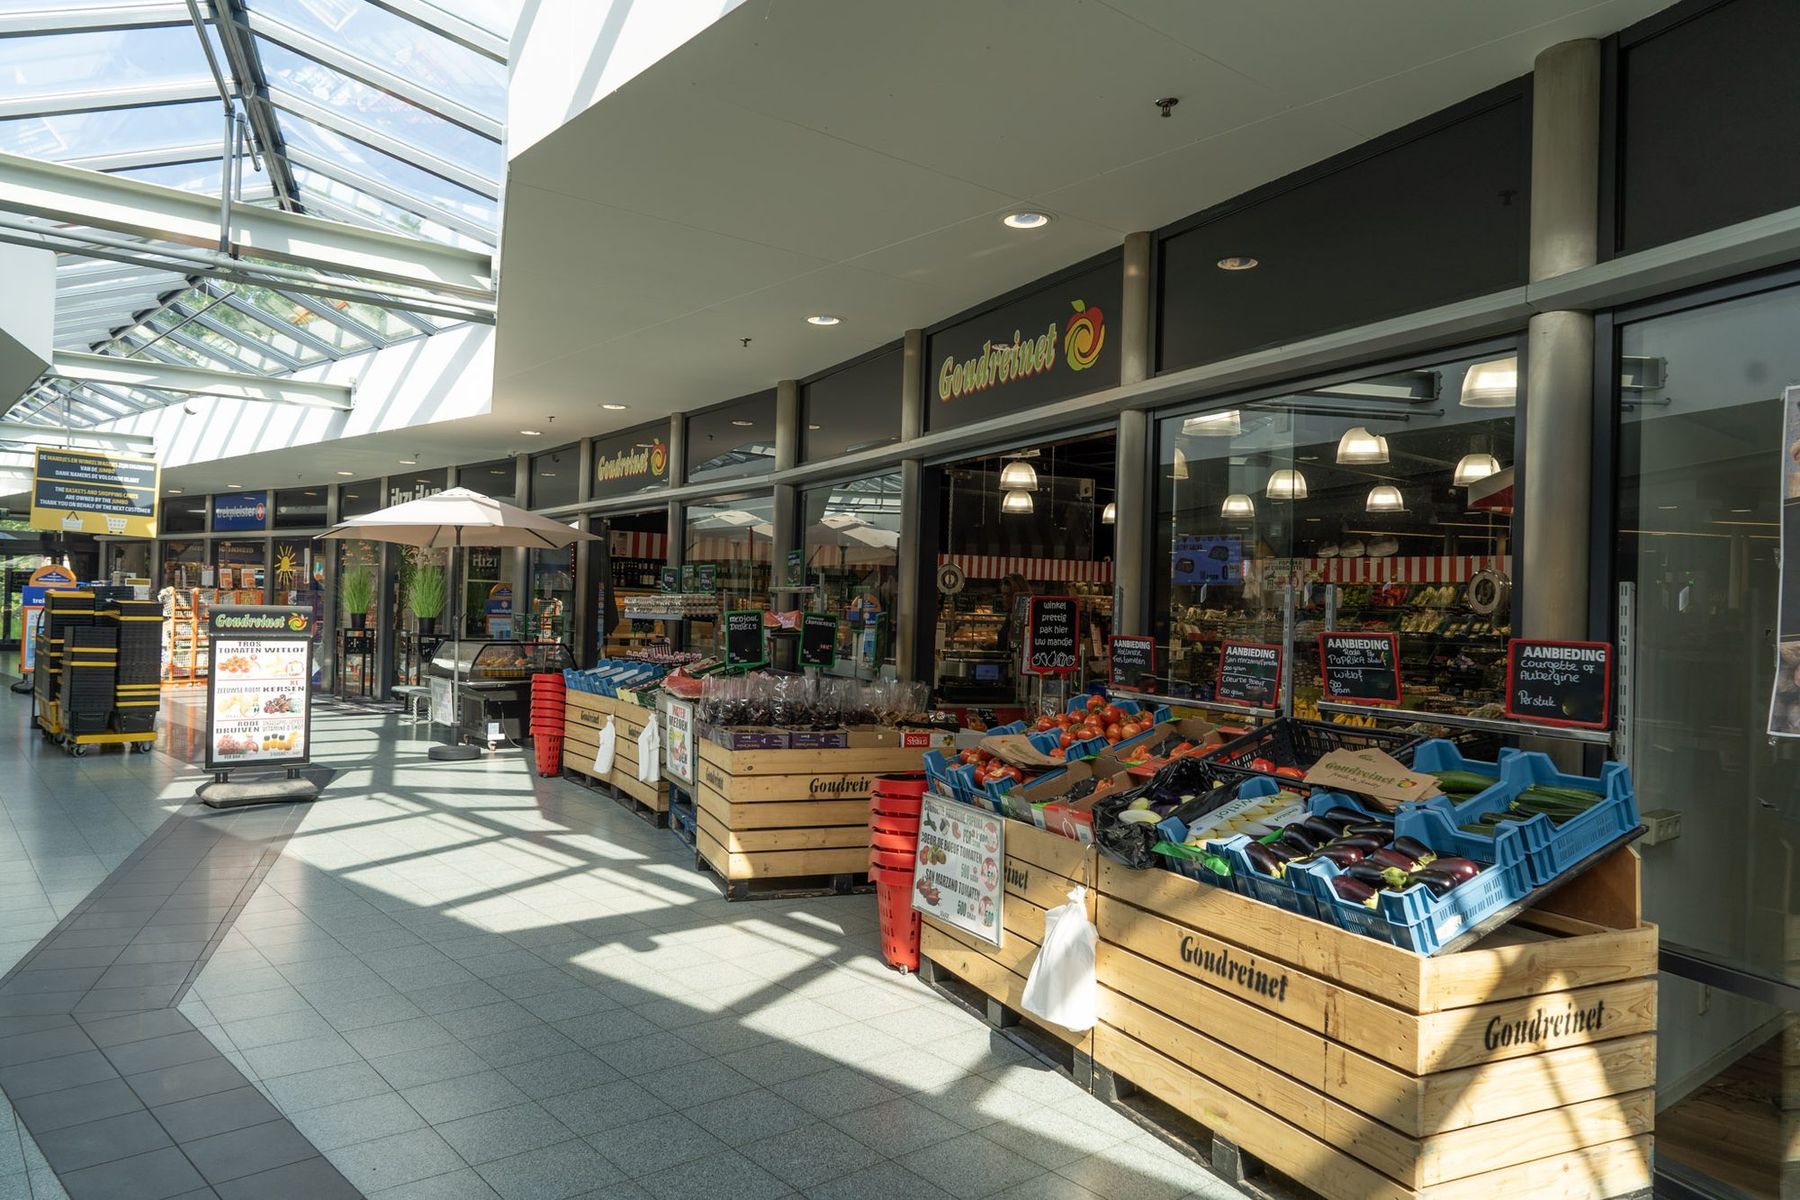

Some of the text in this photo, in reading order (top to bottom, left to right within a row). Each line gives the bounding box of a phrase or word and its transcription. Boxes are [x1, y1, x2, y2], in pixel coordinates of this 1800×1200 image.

[938, 323, 1058, 401] Goudreinet
[598, 448, 649, 481] Goudreinet
[1043, 601, 1066, 610] winkel
[215, 613, 285, 628] Goudreinet
[1042, 613, 1067, 623] prettig
[1039, 625, 1068, 634] pak hier
[1047, 637, 1073, 646] mandje
[1114, 640, 1150, 650] AANBIEDING
[1328, 639, 1389, 650] AANBIEDING
[1226, 646, 1275, 658] AANBIEDING
[1523, 646, 1606, 662] AANBIEDING
[1583, 664, 1595, 674] of
[1520, 670, 1580, 685] Aubergine
[1180, 936, 1288, 1002] Goudreinet
[1484, 1000, 1604, 1051] Goudreinet
